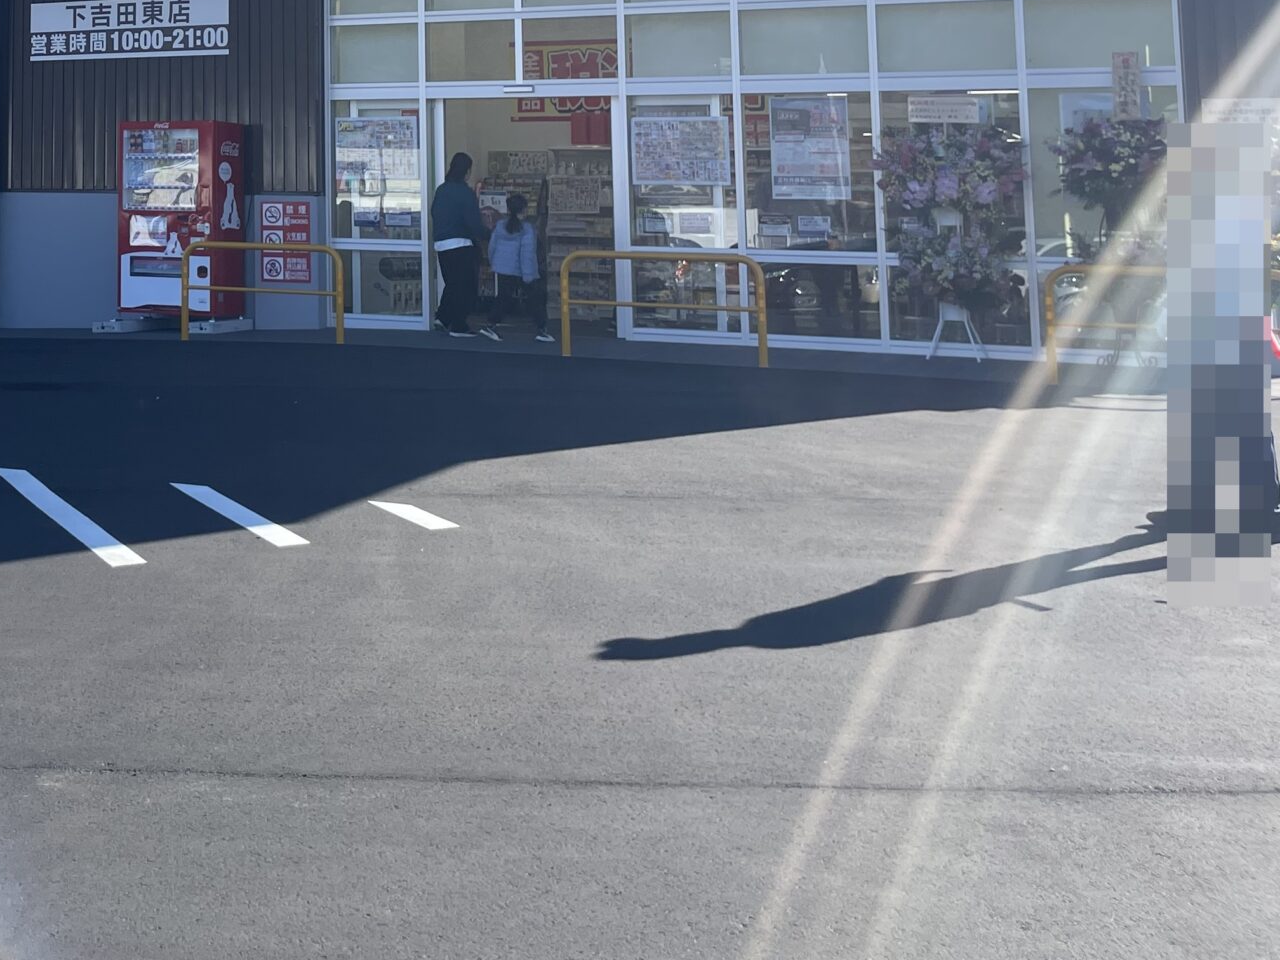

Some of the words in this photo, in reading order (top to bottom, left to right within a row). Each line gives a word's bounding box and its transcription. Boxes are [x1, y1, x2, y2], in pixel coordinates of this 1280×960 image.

[66, 0, 191, 29] 下吉田東店
